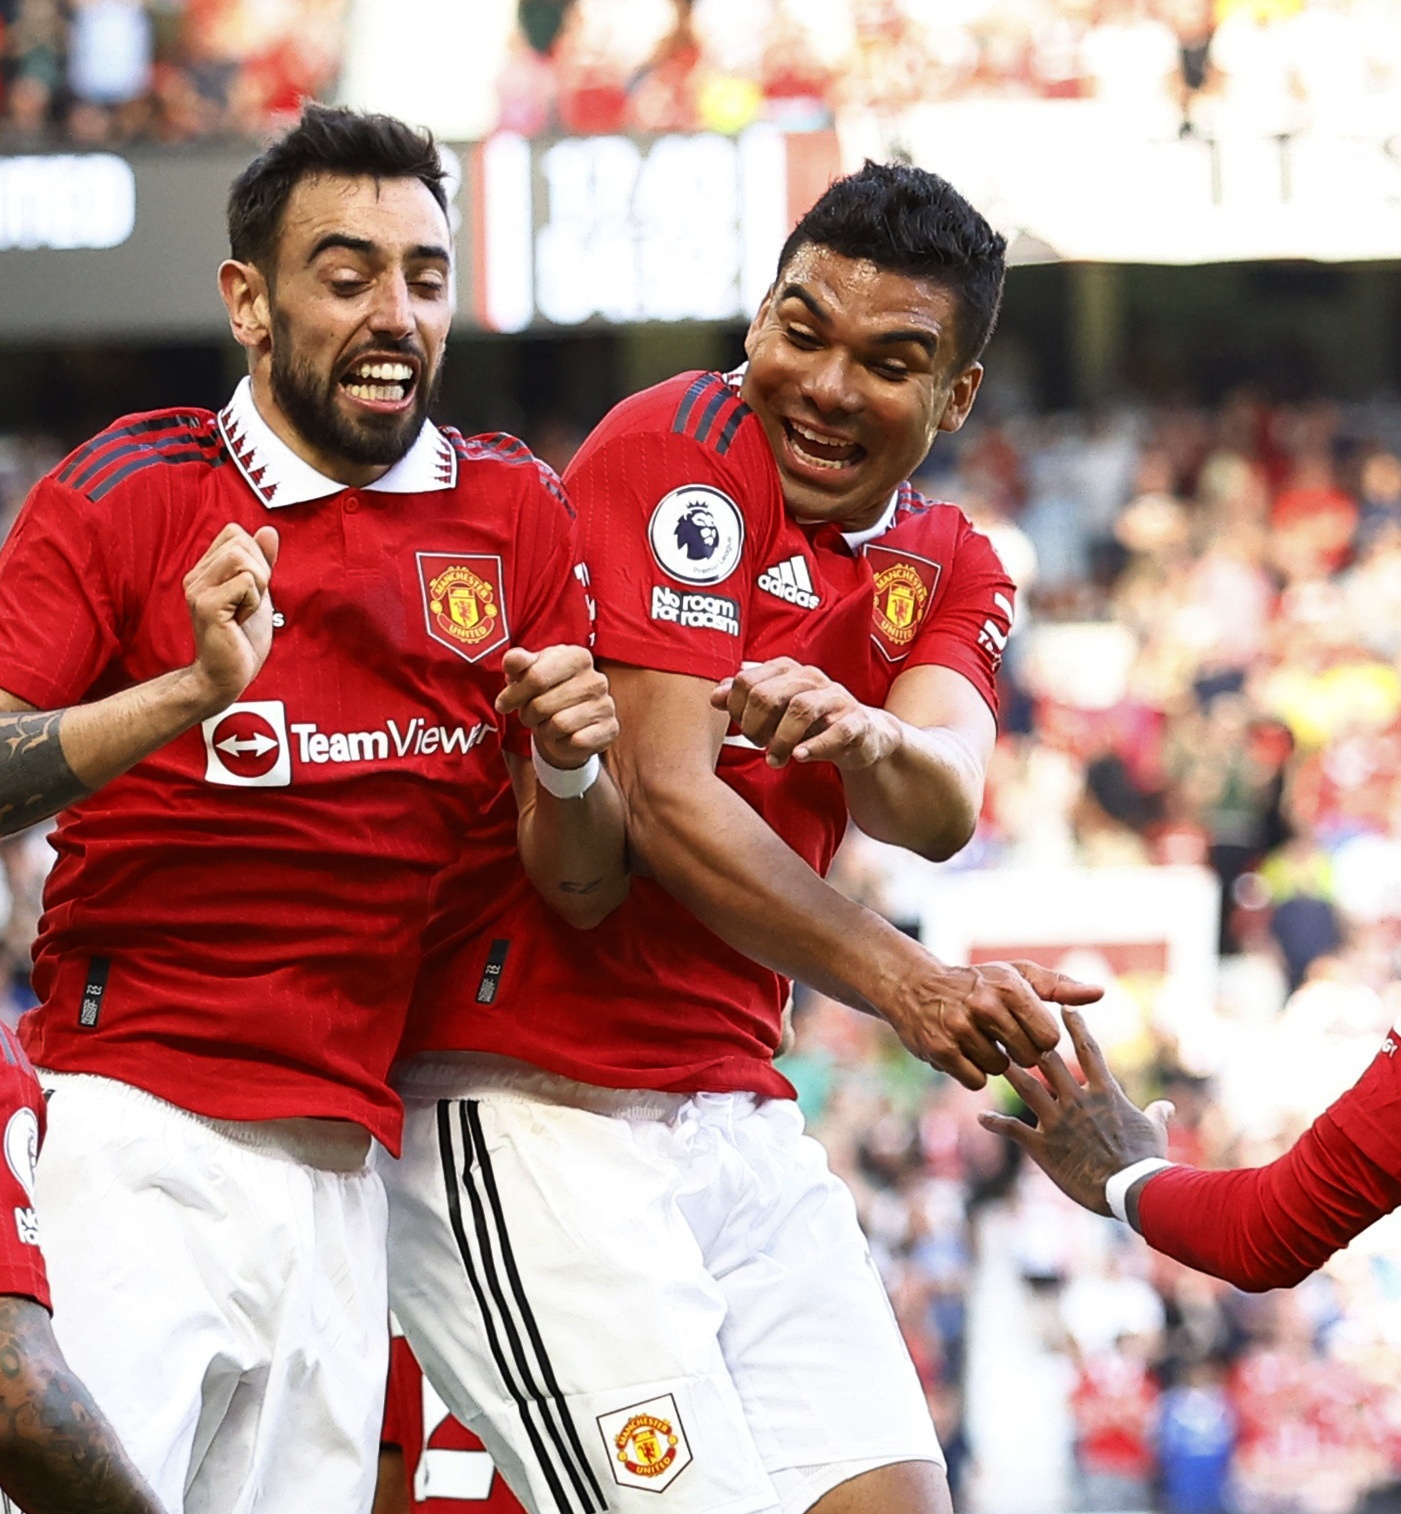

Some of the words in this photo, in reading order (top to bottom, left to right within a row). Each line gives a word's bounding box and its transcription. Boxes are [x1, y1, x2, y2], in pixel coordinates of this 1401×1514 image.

[434, 572, 489, 599] MANCHESTER
[757, 574, 821, 610] adidas
[875, 569, 926, 603] MANCHESTER
[652, 586, 680, 608] No
[682, 594, 735, 618] room
[448, 624, 487, 638] UNITED
[681, 611, 739, 637] racism
[619, 1417, 669, 1445] MANCHESTER
